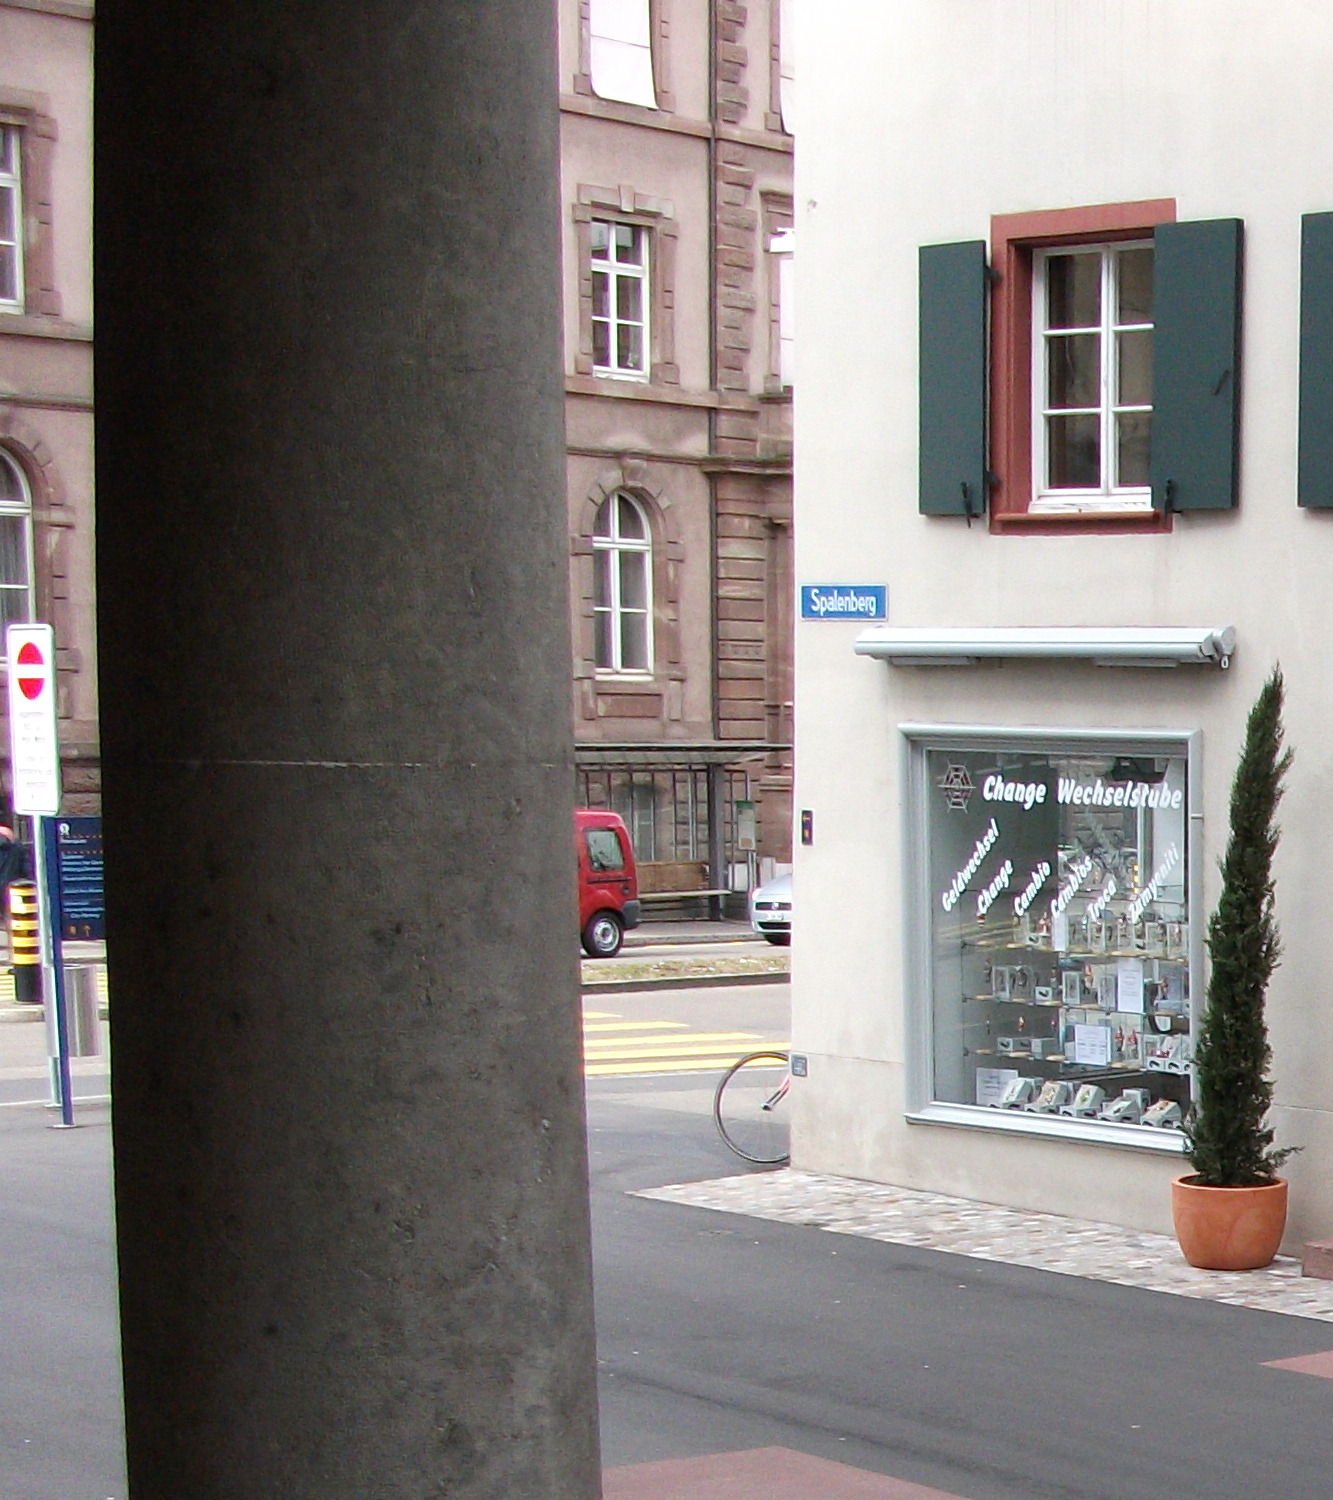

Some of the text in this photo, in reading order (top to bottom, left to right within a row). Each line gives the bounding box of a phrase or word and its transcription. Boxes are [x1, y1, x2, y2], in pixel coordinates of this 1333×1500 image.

[811, 588, 876, 616] Spalenberg
[983, 775, 1182, 811] Change Wechselstube
[942, 818, 999, 912] Geldwechsel
[978, 860, 1013, 915] Change
[1014, 862, 1051, 916] Cambio
[1051, 855, 1092, 917] Cambios
[1087, 879, 1117, 922] Troca
